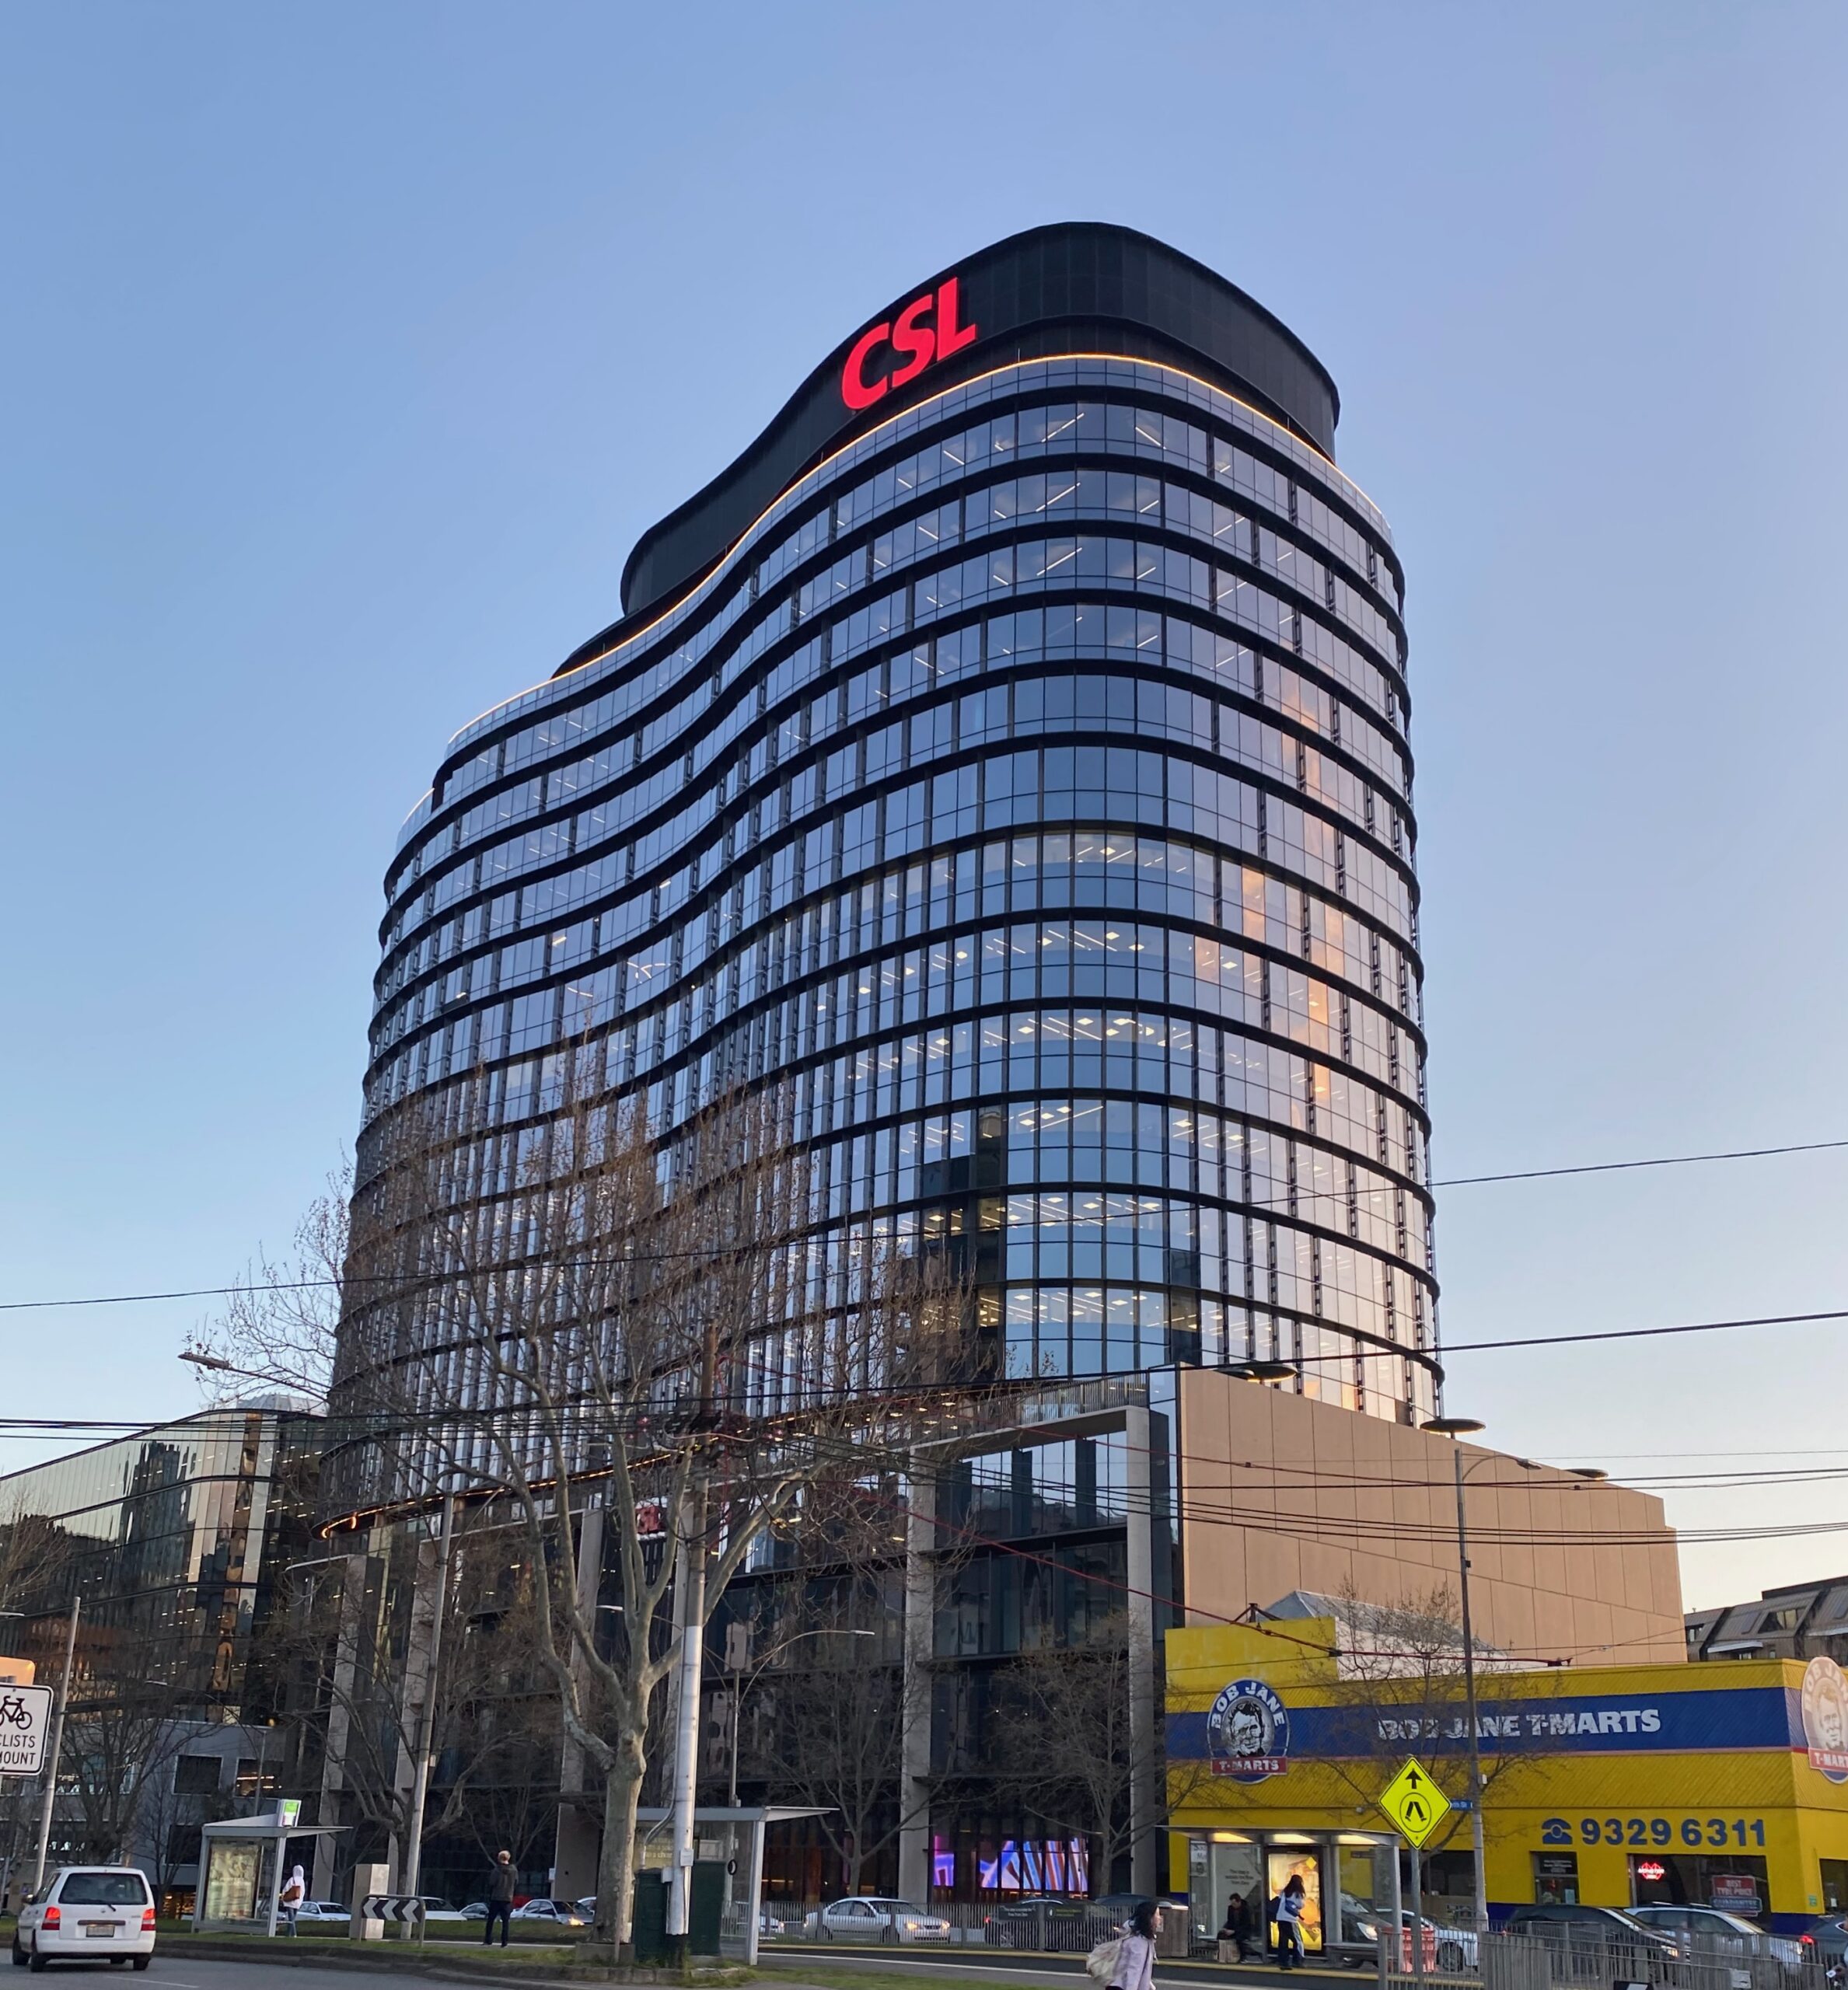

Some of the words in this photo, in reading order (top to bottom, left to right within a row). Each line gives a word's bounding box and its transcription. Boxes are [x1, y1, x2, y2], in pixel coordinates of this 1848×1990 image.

[842, 277, 976, 410] CSL
[1211, 1685, 1239, 1729] BOB
[1245, 1681, 1285, 1726] JANE
[1378, 1719, 1438, 1740] BOB
[1526, 1709, 1661, 1736] T-MARTS
[1219, 1760, 1279, 1771] T-MARTS
[1581, 1818, 1672, 1845] 9329
[1681, 1818, 1765, 1847] 6311
